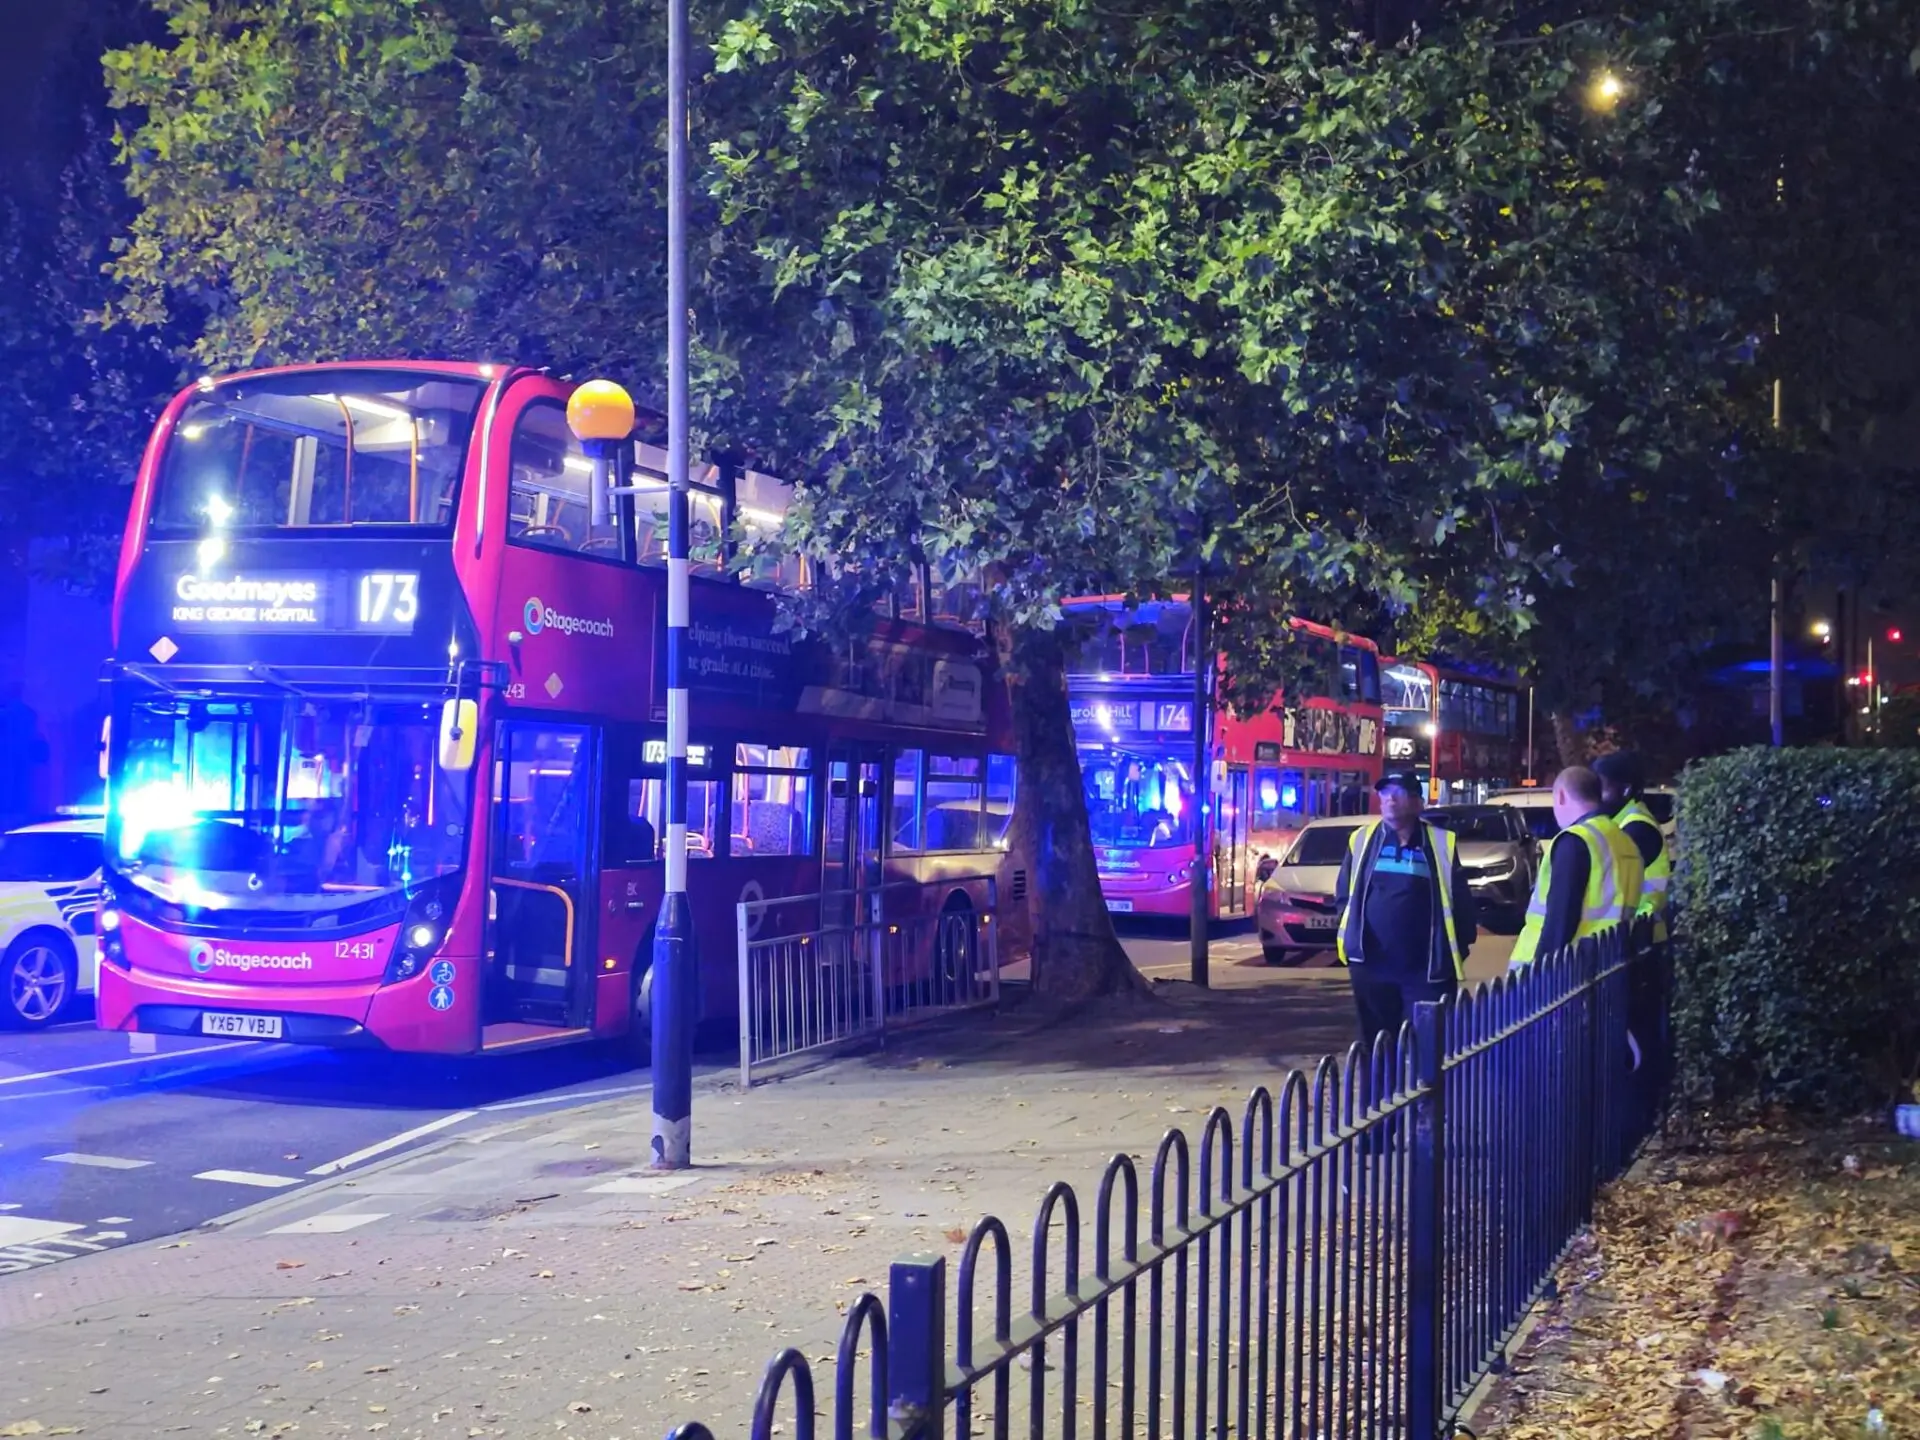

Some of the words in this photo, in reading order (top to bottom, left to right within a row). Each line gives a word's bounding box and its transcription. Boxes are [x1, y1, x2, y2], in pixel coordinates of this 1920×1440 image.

[176, 574, 317, 607] Goodmayes
[360, 574, 418, 622] 173
[172, 607, 203, 621] KING
[206, 607, 255, 622] GEORGE
[259, 607, 317, 622] HOSPITAL
[544, 608, 613, 638] Stagecoach
[688, 621, 722, 650] elping
[1110, 706, 1132, 719] Hill
[1161, 704, 1188, 727] 174
[216, 950, 312, 970] Stagecoach
[335, 942, 374, 960] 12431
[208, 1016, 244, 1033] YX67
[249, 1018, 275, 1035] VBJ
